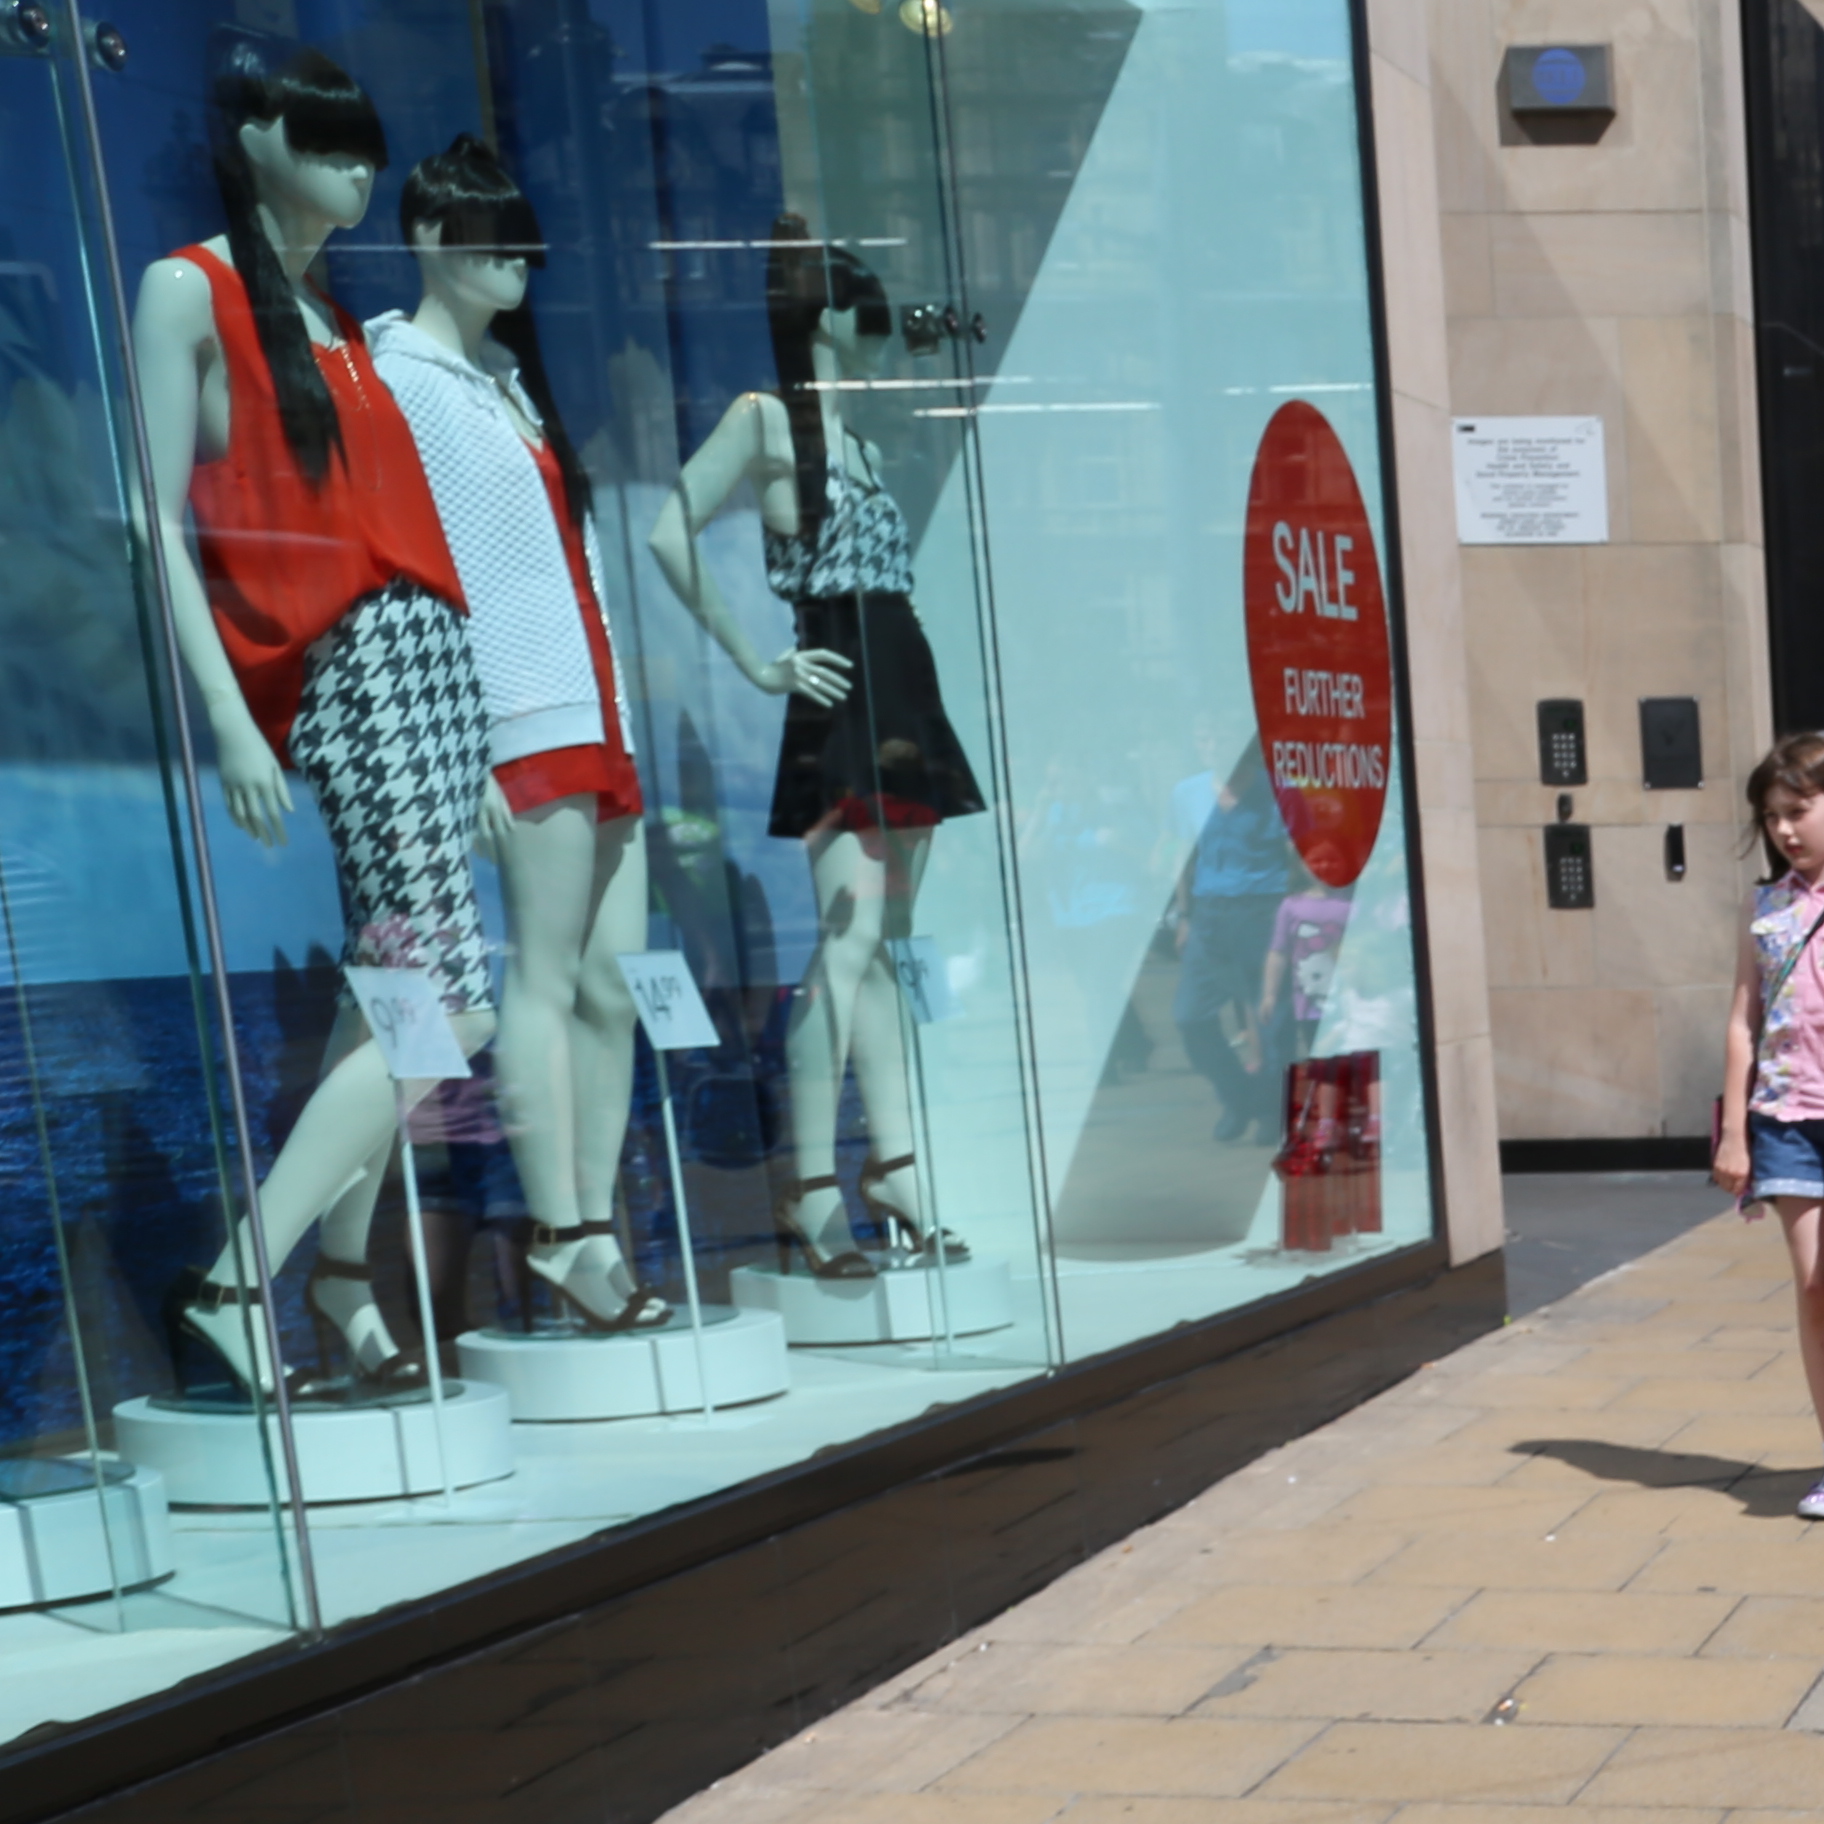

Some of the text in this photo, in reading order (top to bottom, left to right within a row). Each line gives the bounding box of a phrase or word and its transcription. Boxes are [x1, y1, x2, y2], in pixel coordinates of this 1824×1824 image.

[1273, 520, 1359, 621] SALE
[1283, 667, 1365, 719] FURTHER
[1272, 740, 1385, 789] REDUCTIONS
